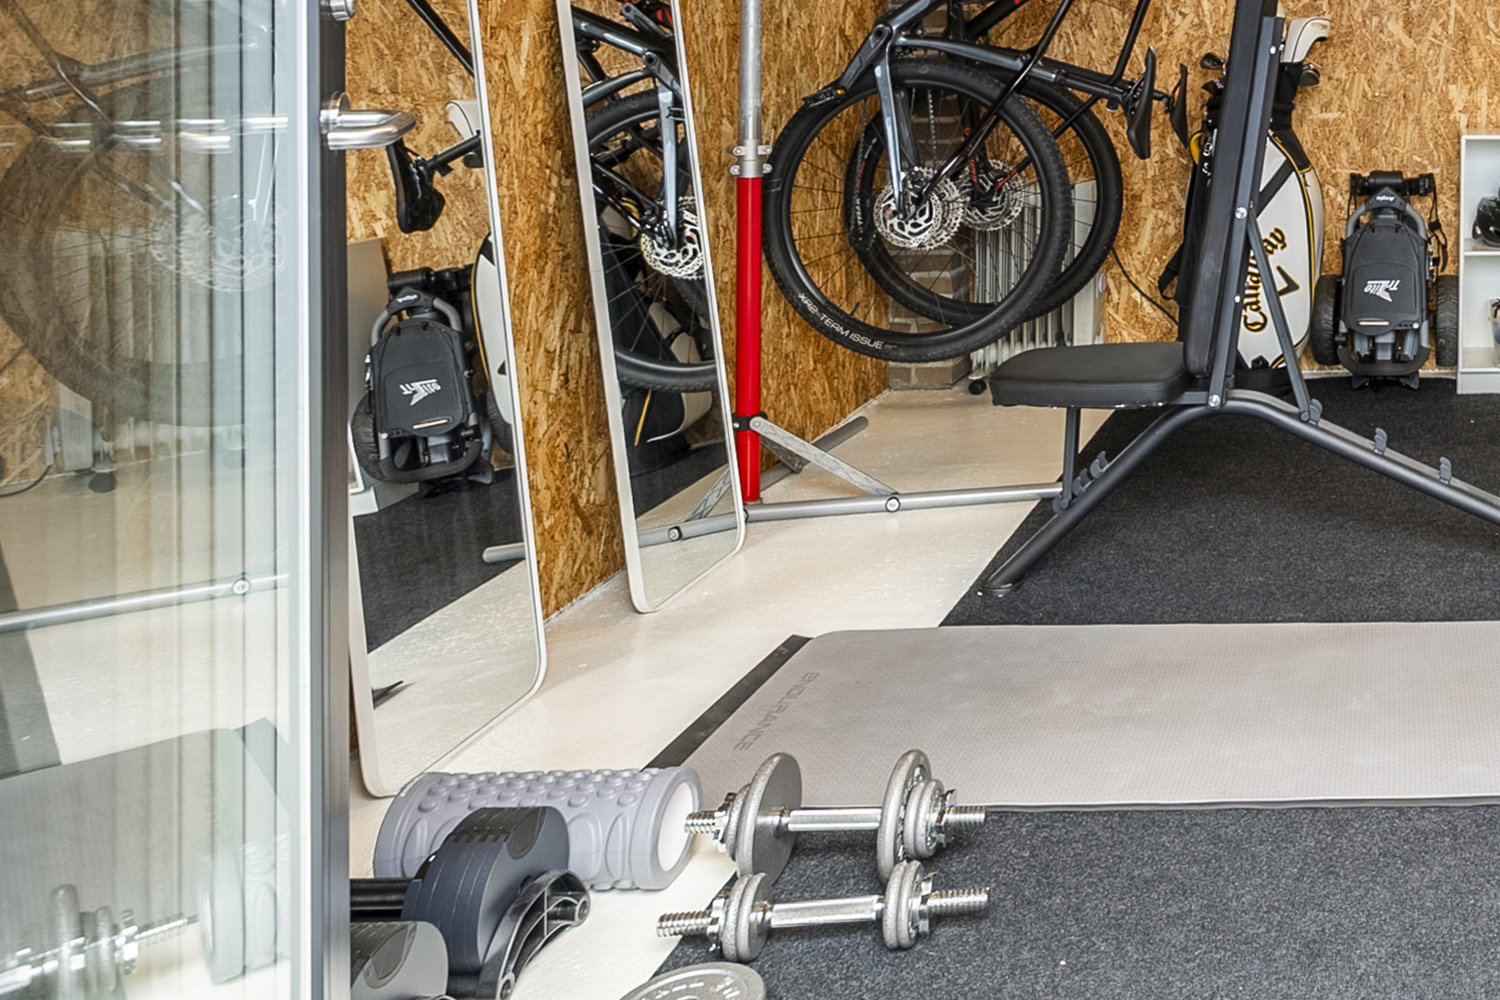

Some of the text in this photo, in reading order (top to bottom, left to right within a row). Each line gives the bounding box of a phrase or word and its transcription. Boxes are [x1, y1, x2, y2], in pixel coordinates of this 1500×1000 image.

[1243, 227, 1287, 333] Callaay
[798, 292, 884, 350] XR2 TEAM ISSUE
[733, 672, 820, 750] ENDURANCE
